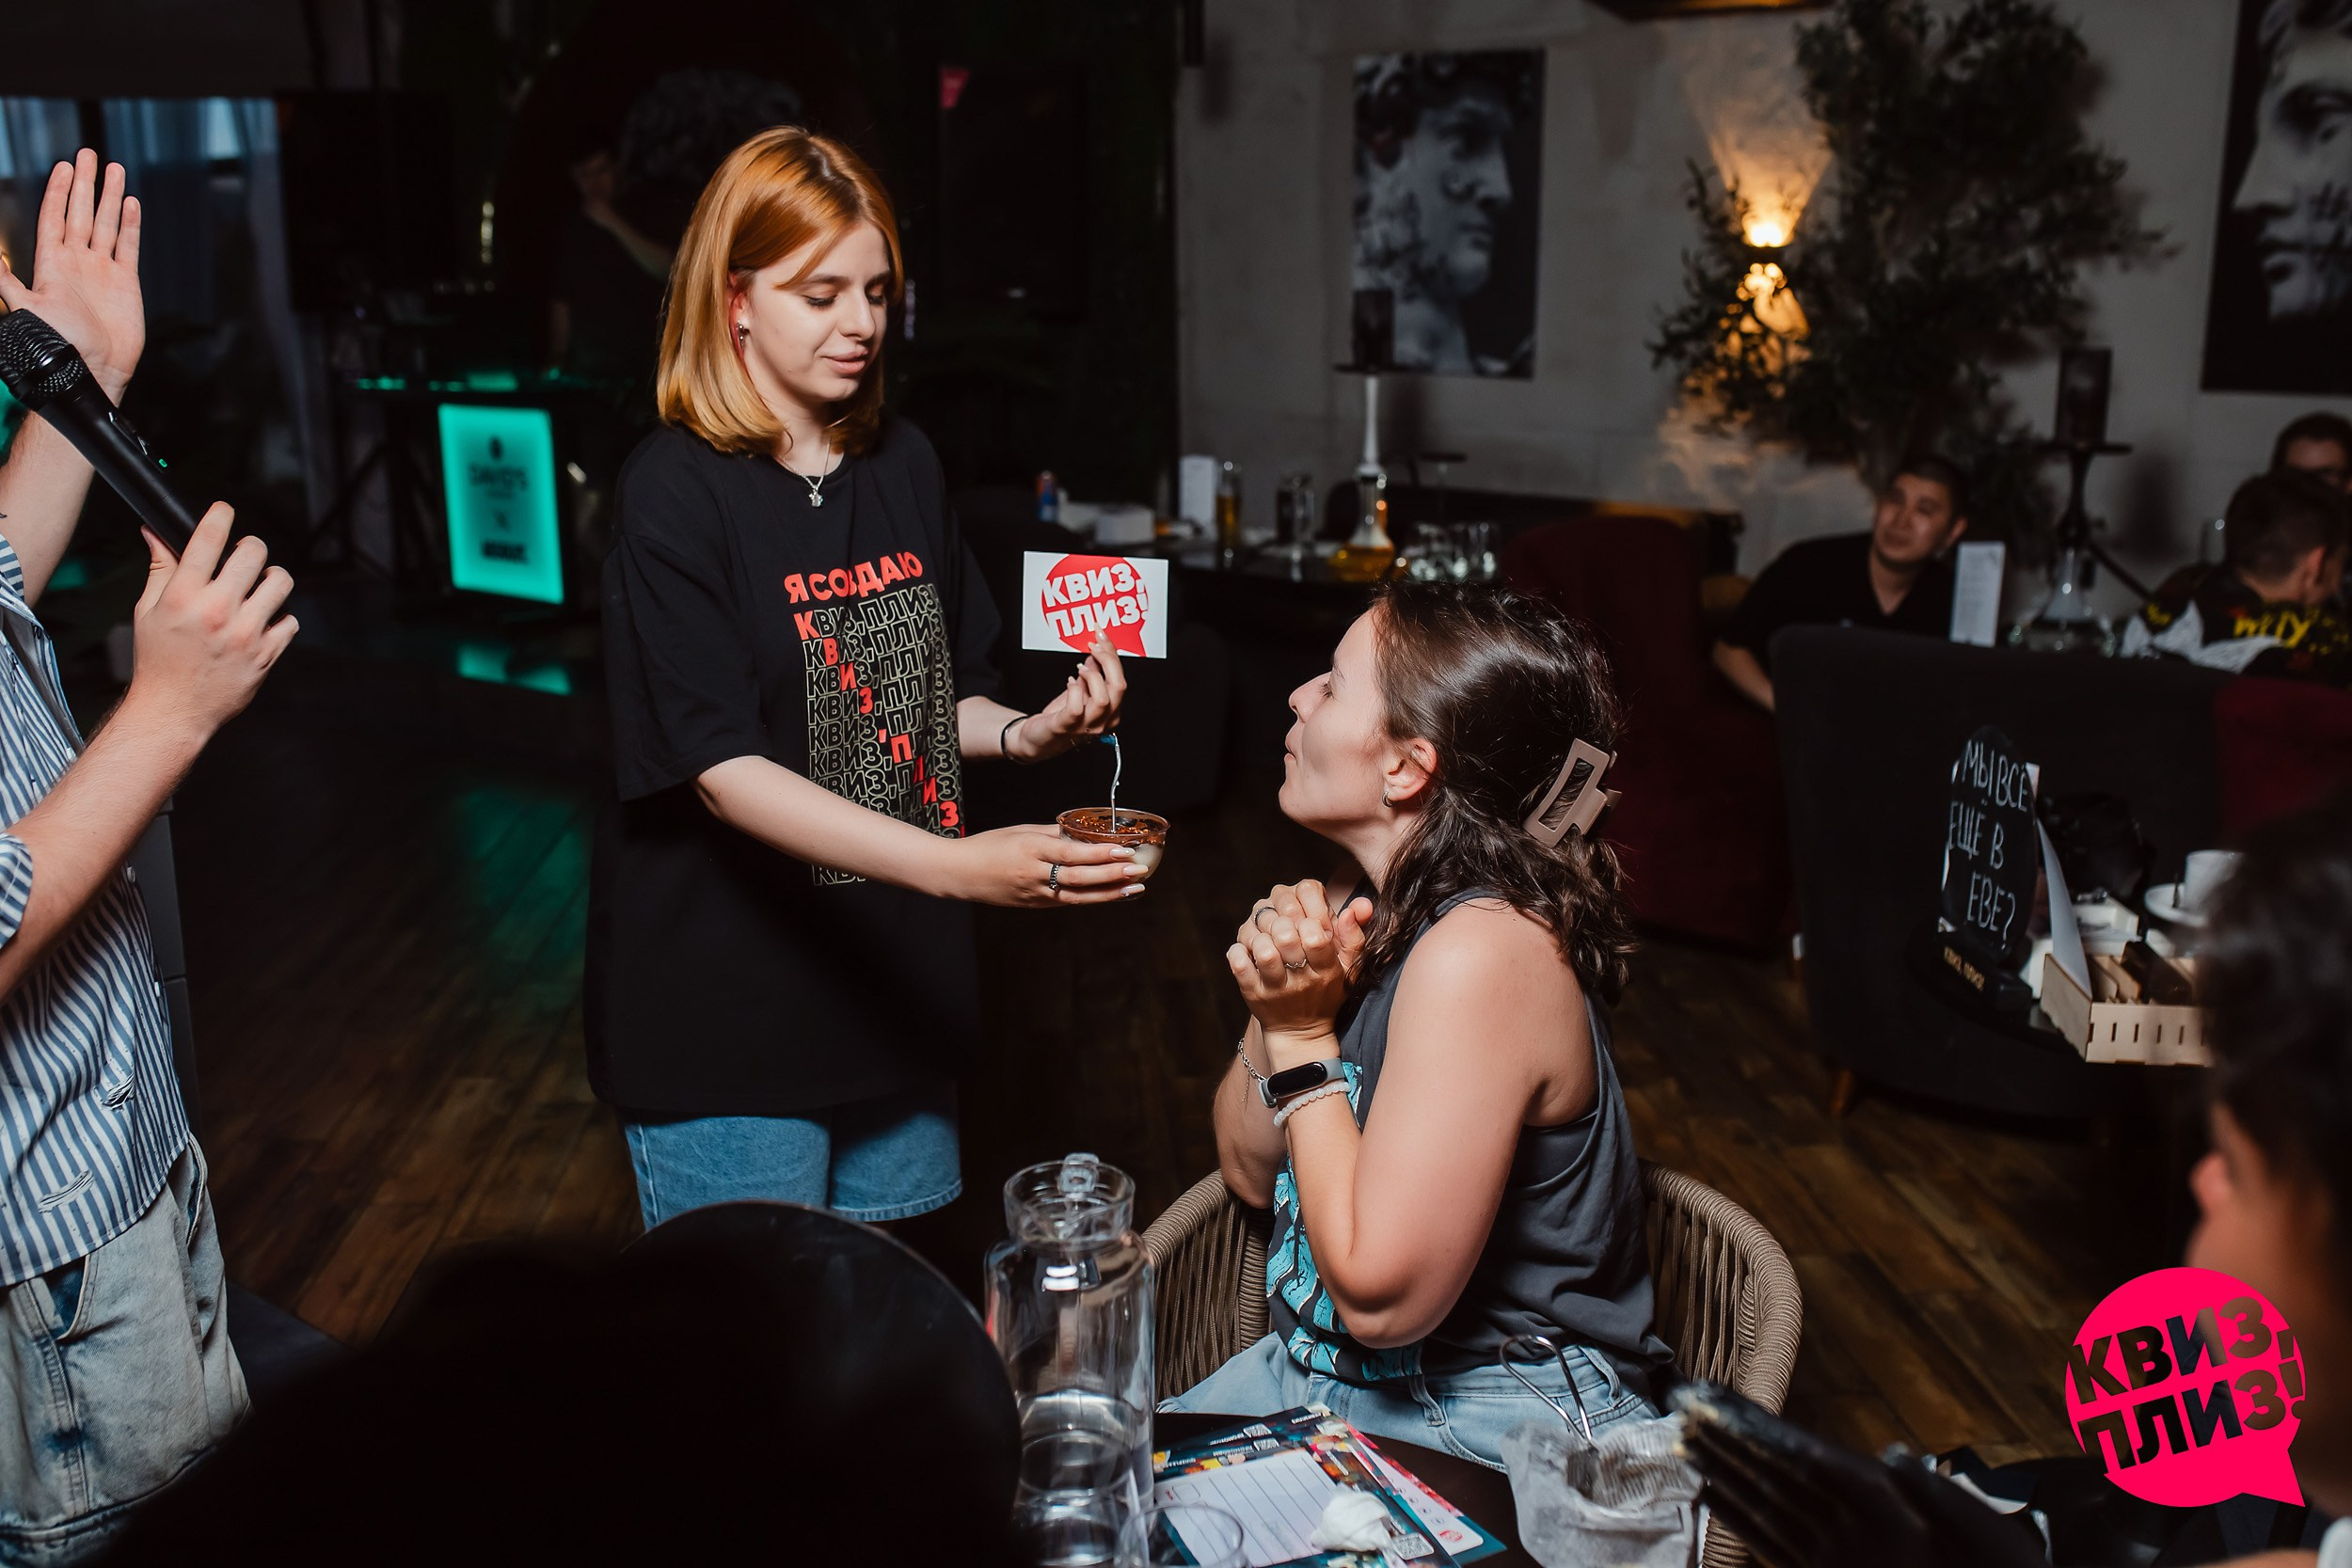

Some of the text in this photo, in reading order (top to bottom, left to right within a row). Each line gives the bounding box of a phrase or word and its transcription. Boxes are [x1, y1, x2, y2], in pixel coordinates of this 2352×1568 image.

[784, 551, 924, 605] Я СОЗДАЮ
[1041, 562, 1146, 608] КВИЗ,
[1045, 593, 1149, 639] ПЛИЗ!
[1961, 738, 1994, 798] МЫ
[1990, 821, 2005, 869] В
[1966, 870, 2016, 951] ЕВЕ?
